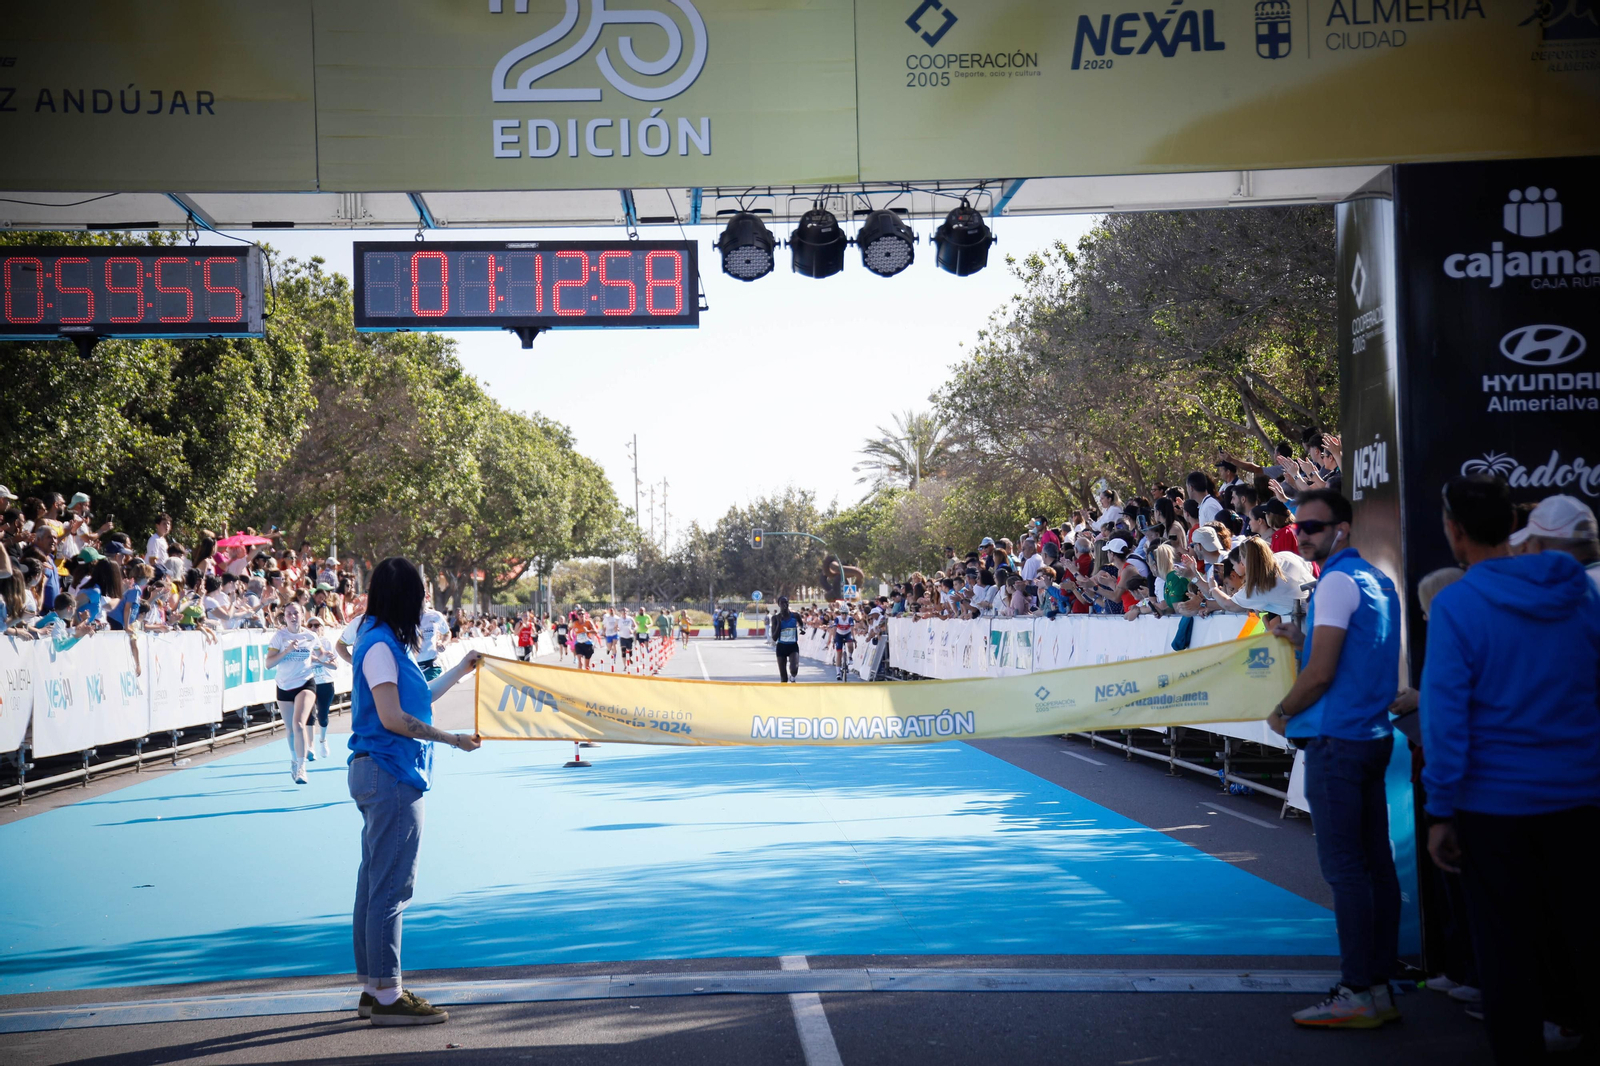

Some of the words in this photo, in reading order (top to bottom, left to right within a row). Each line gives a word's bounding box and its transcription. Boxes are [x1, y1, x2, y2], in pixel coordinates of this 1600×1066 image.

[1326, 29, 1407, 50] CIUDAD
[906, 49, 1038, 70] COOPERACIÓN
[1083, 59, 1113, 70] 2020
[906, 71, 951, 88] 2005
[0, 88, 18, 112] Z
[35, 83, 216, 116] ANDÚJAR
[492, 108, 711, 158] EDICIÓN
[1531, 277, 1569, 289] CAJA
[1487, 394, 1600, 412] Almerialva
[585, 701, 628, 716] Medio
[633, 706, 692, 720] Maratón
[650, 720, 692, 735] 2024
[751, 715, 838, 740] MEDIO
[843, 708, 974, 740] MARATÓN
